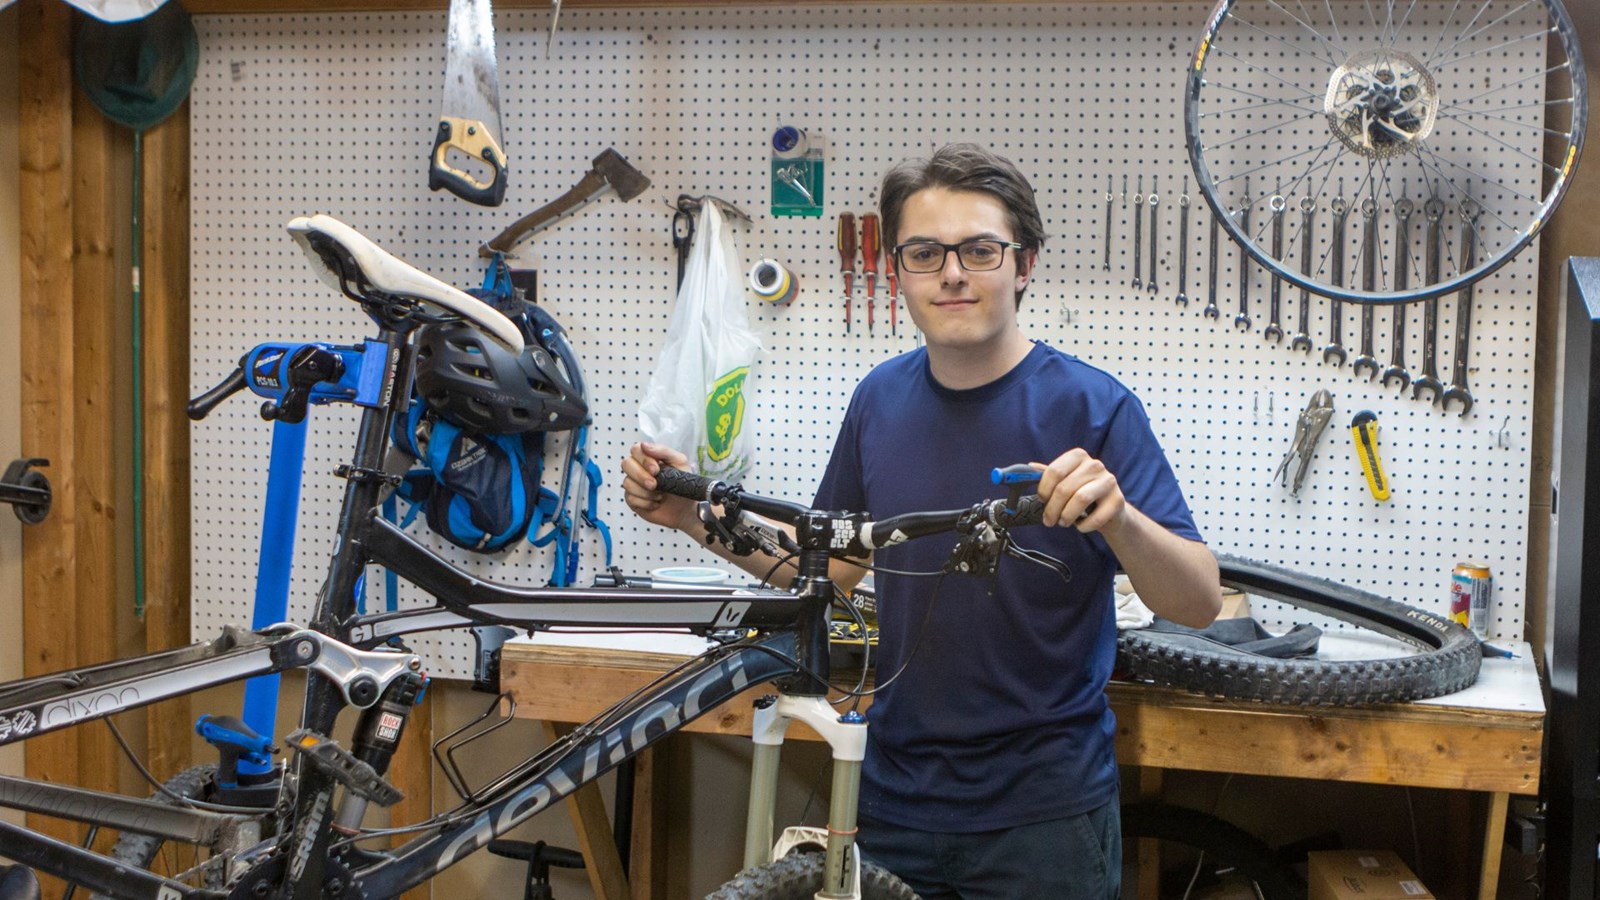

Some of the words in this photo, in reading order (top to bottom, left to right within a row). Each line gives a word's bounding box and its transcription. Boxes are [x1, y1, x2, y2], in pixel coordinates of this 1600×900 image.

[382, 364, 397, 407] EASTON
[1451, 581, 1463, 593] le
[853, 593, 865, 609] 28
[1407, 610, 1449, 632] KENDA
[382, 714, 401, 727] ROCK
[289, 791, 331, 882] SRAM
